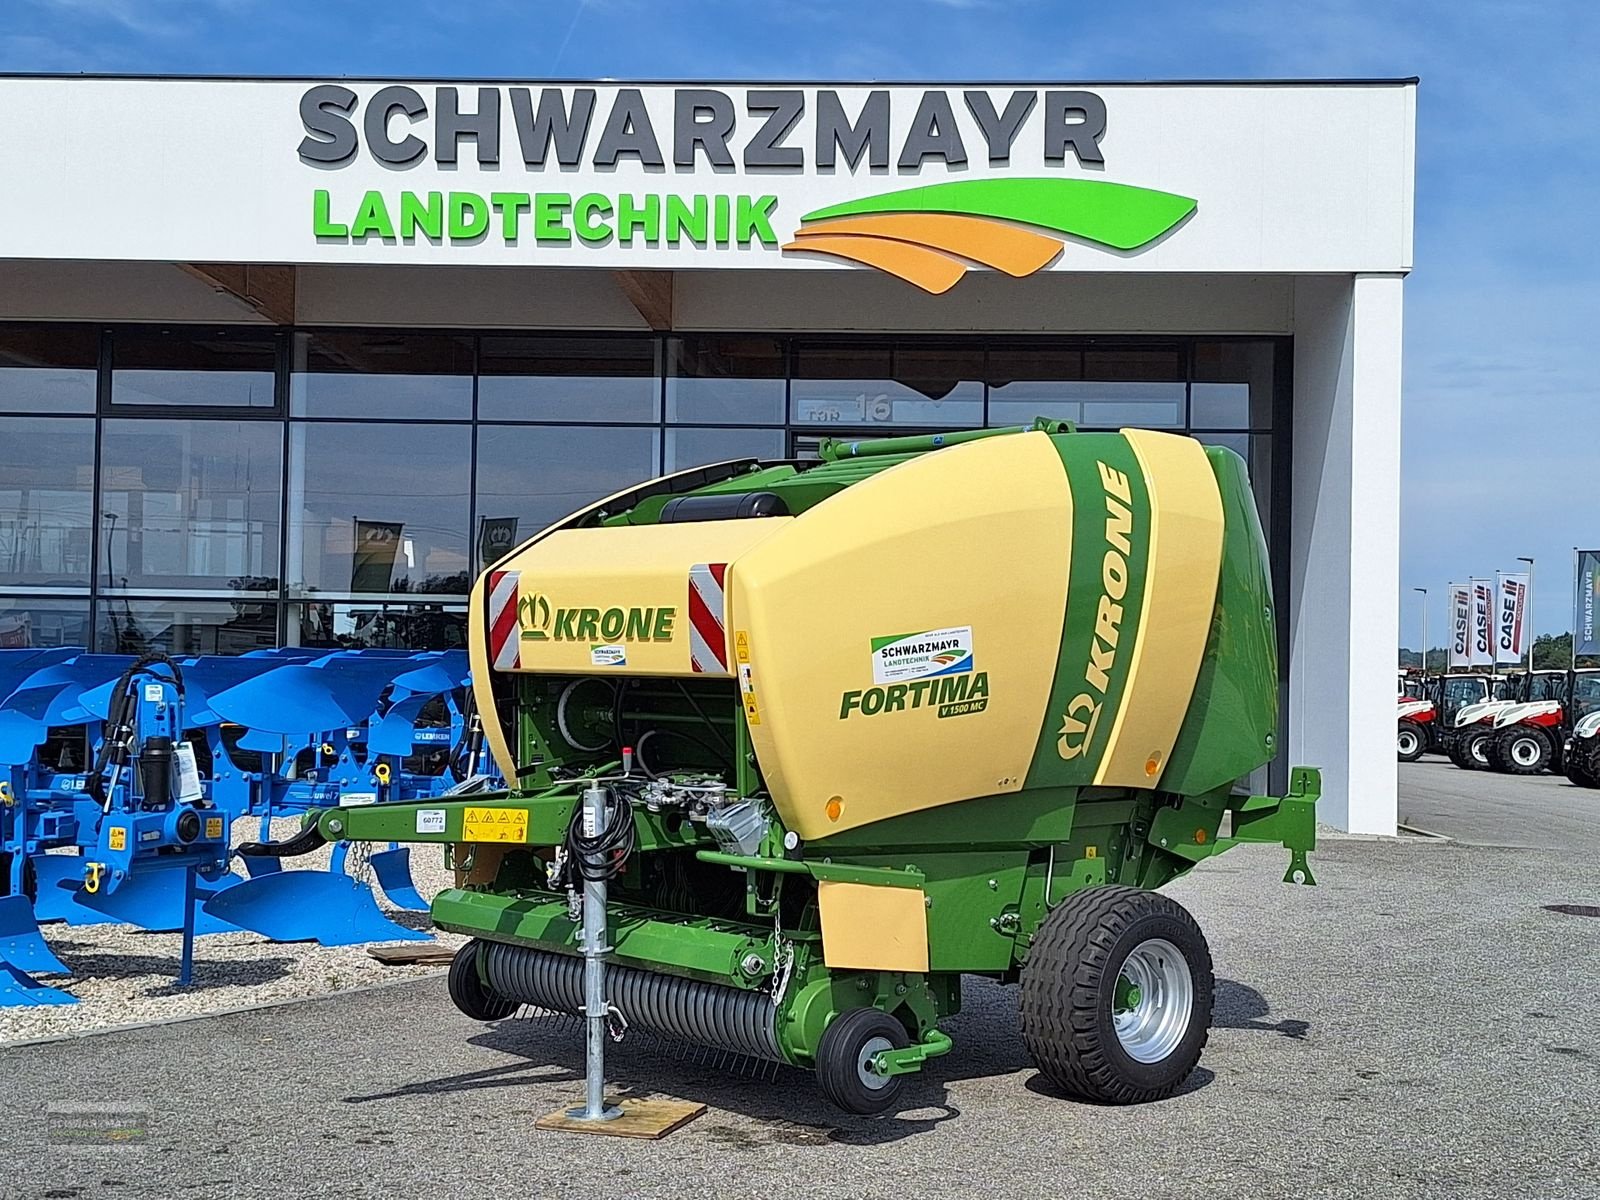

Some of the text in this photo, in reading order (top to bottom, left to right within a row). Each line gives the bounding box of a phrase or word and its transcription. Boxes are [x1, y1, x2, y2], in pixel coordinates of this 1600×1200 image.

[297, 85, 1107, 171] SCHWARZMAYR
[314, 190, 778, 244] LANDTECHNIK
[855, 394, 892, 422] 16
[1085, 460, 1133, 694] KRONE
[554, 607, 677, 642] KRONE
[1455, 608, 1468, 654] CASE
[1477, 603, 1487, 652] CASE
[1500, 598, 1516, 650] CASE
[1584, 571, 1593, 642] SCHWARZMAYR
[881, 639, 960, 658] SCHWARZMAYR
[883, 655, 930, 668] LANDTECHNIK
[839, 671, 989, 720] FORTIMA
[941, 701, 984, 716] V 1500 MC
